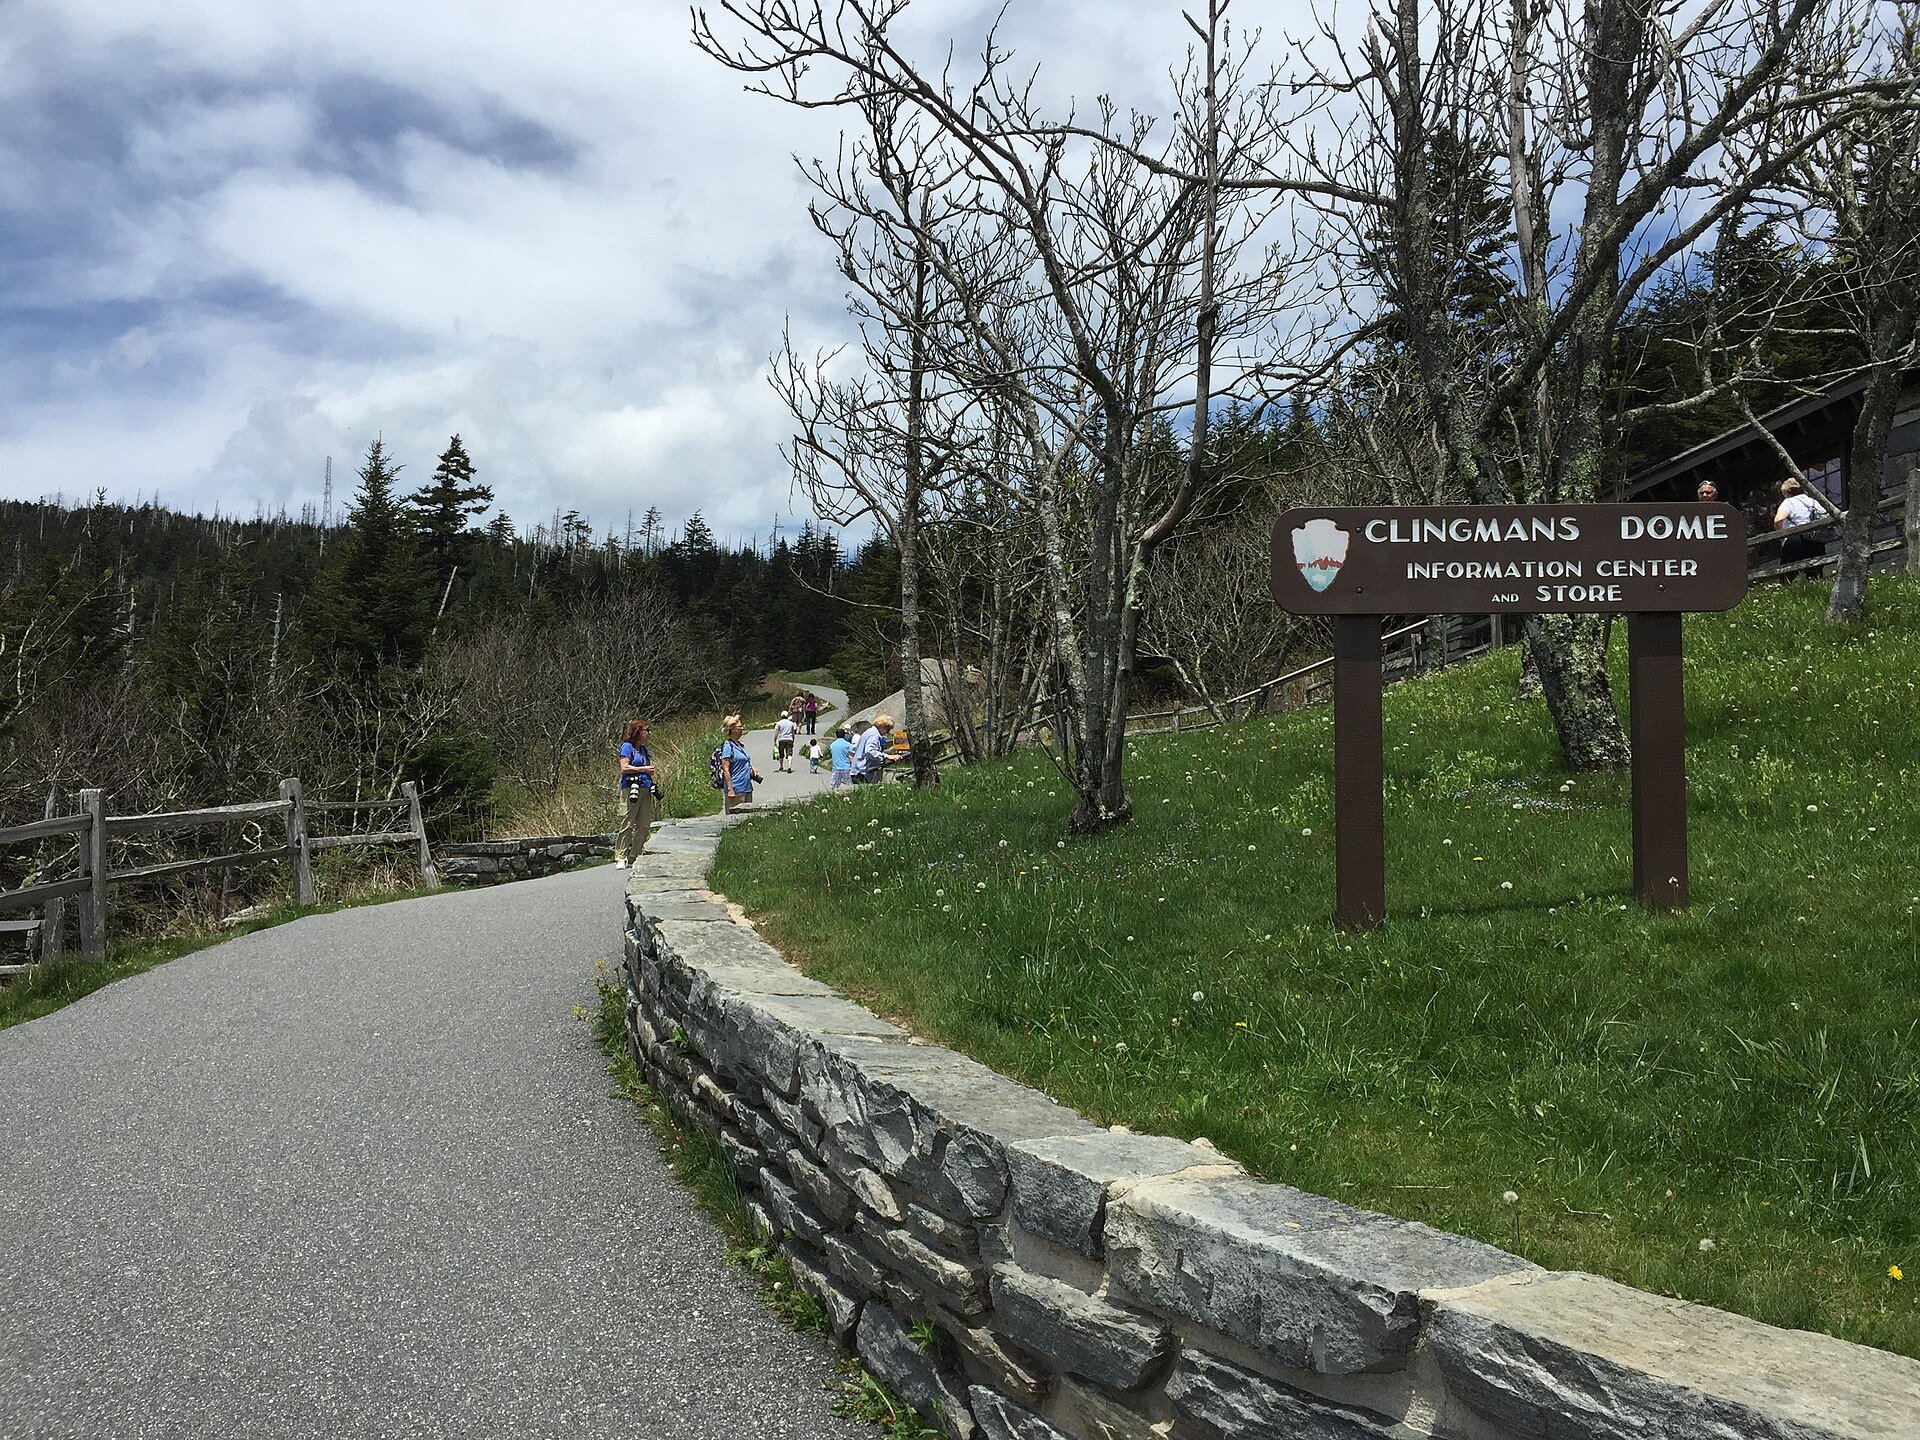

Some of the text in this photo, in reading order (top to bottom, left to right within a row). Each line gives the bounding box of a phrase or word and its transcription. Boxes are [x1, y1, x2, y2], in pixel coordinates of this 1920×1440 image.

[1364, 514, 1729, 543] CLINGMANS DOME
[1406, 559, 1698, 580] INFORMATION CENTER
[1491, 584, 1623, 603] AND STORE
